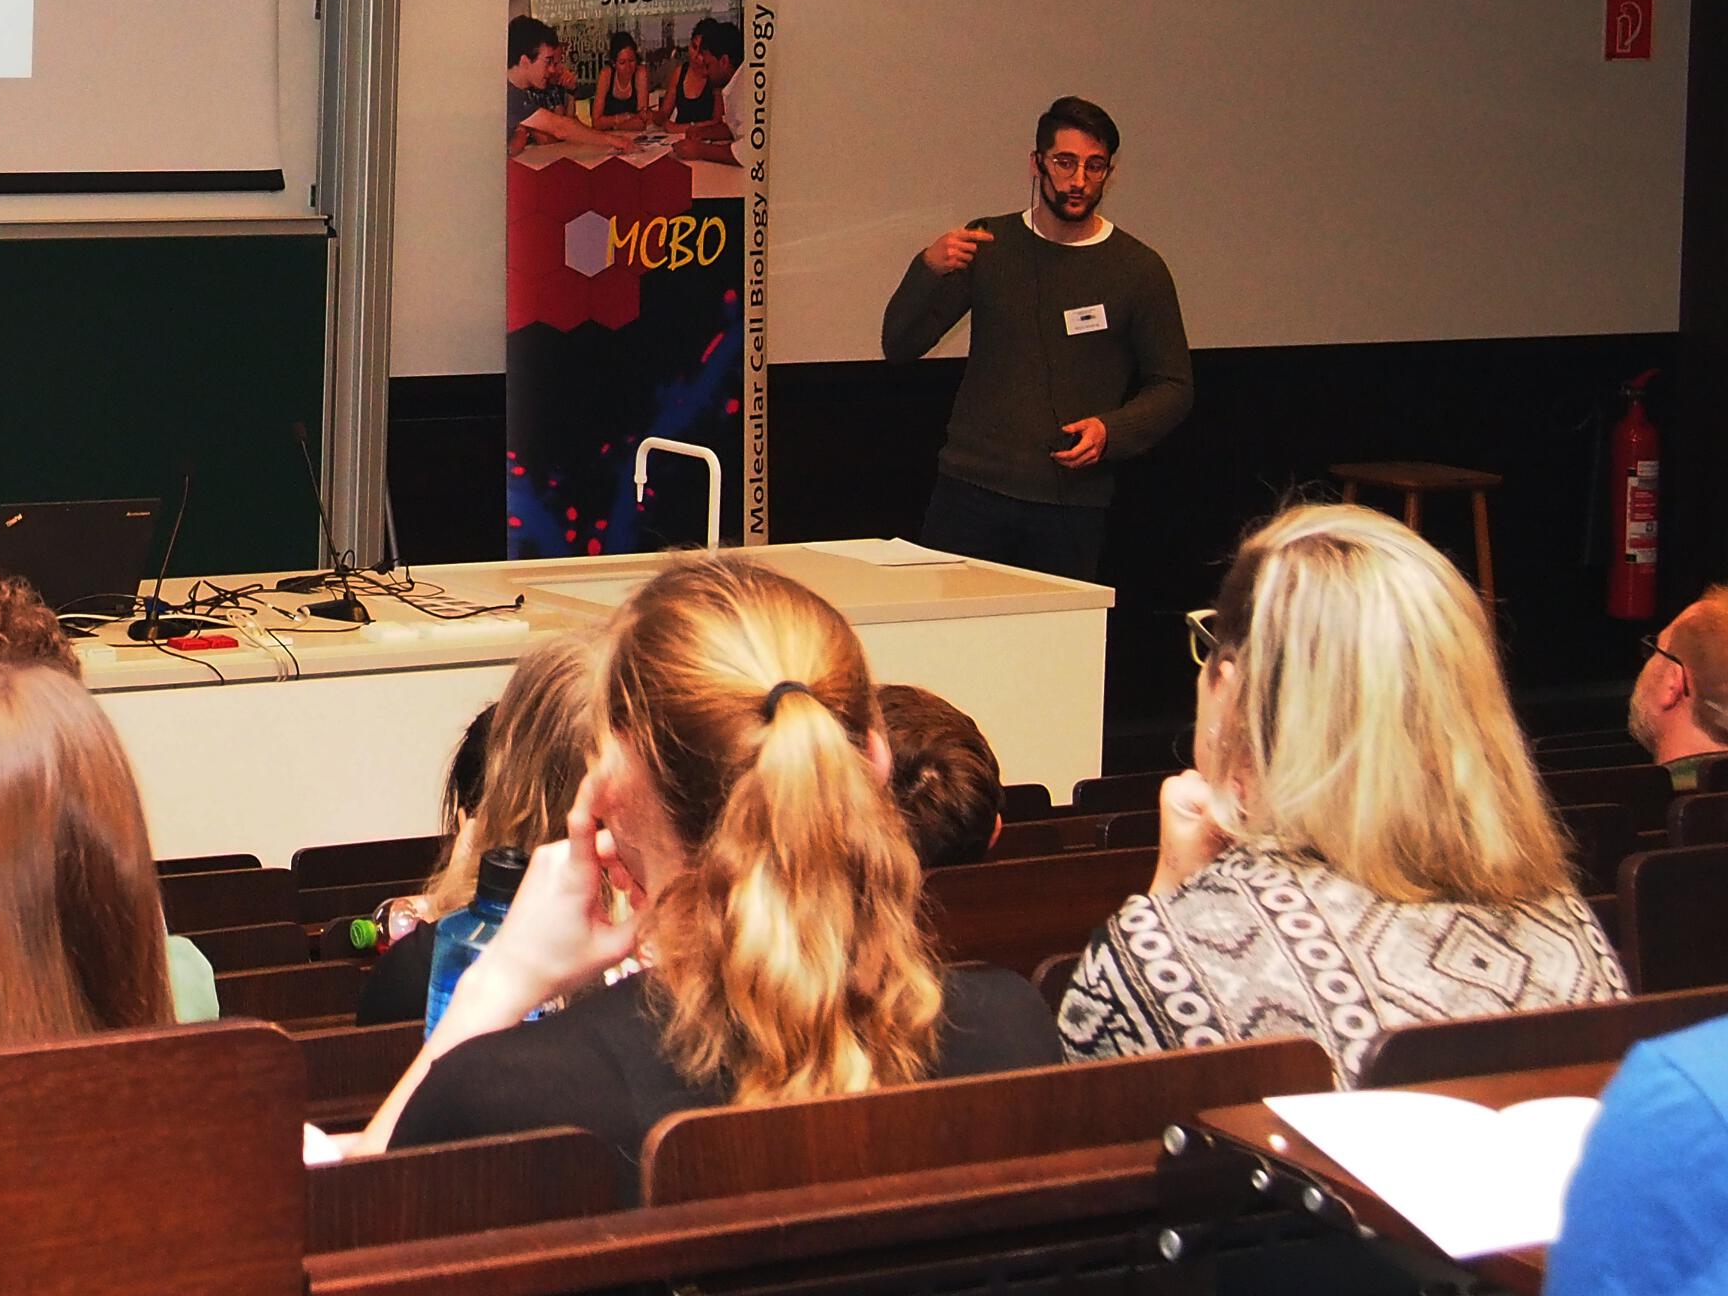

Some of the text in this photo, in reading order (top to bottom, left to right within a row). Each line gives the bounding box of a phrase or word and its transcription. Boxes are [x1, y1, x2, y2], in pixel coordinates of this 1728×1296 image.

[605, 214, 727, 271] MCBO
[749, 3, 775, 535] Molecular Cell Biology & Oncology
